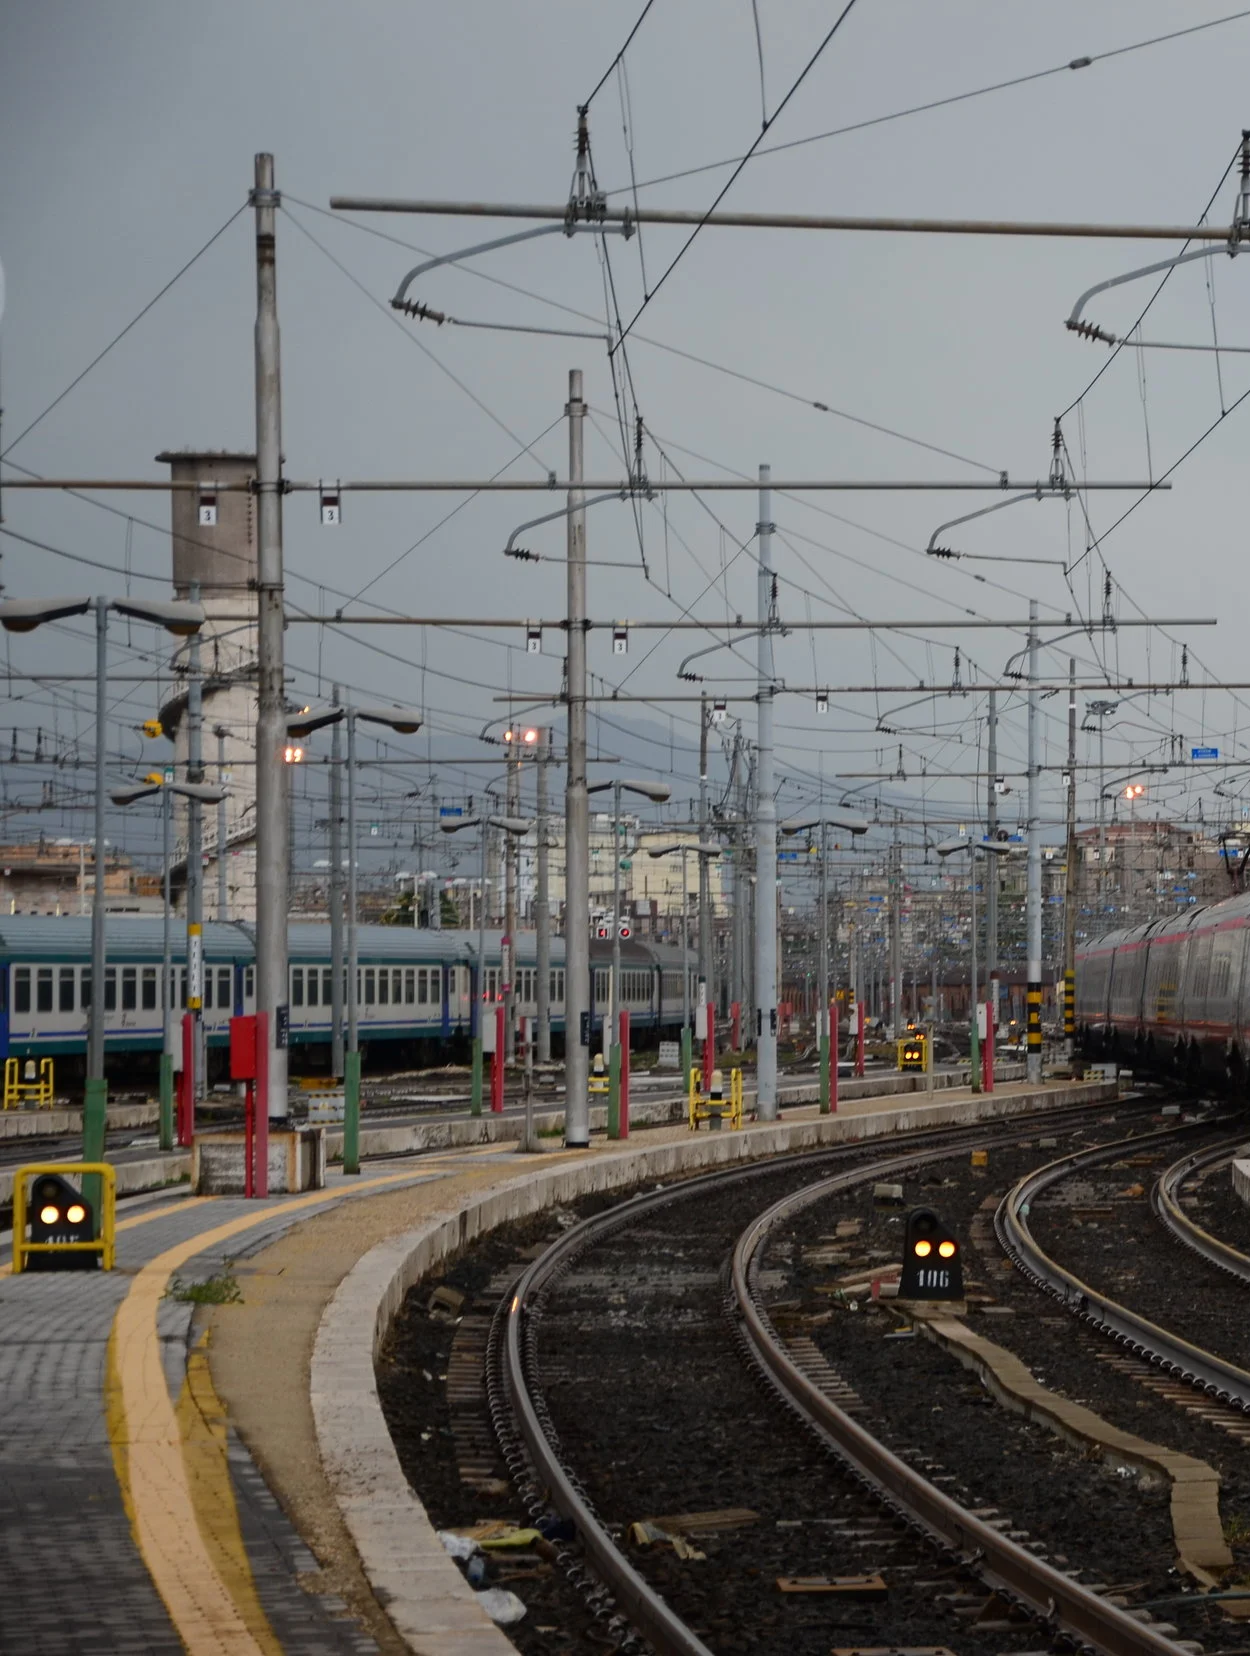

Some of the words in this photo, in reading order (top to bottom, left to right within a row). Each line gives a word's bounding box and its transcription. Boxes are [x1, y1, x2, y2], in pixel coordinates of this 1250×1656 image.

[205, 510, 211, 521] 3
[327, 510, 334, 521] 3
[532, 642, 537, 651] 3
[617, 642, 623, 651] 3
[917, 1268, 950, 1288] 106
